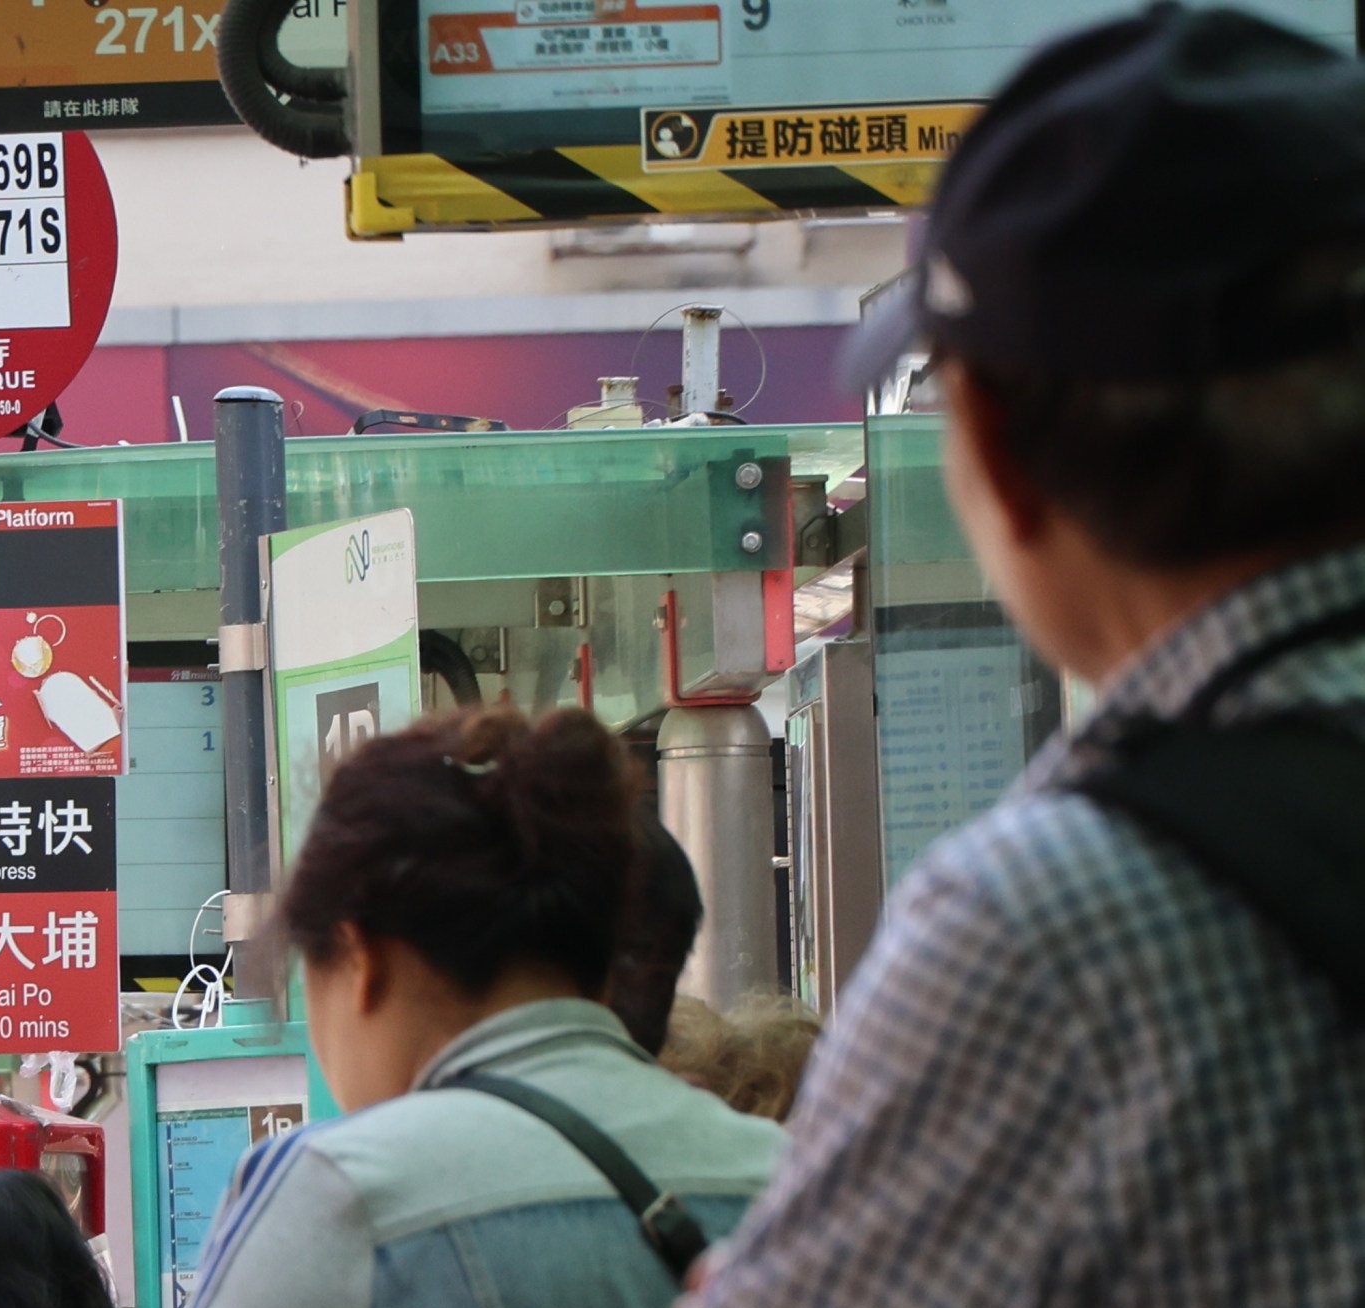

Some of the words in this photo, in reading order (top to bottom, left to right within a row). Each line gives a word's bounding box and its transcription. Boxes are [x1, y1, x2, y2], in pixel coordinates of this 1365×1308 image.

[434, 43, 480, 63] A33
[44, 97, 140, 117] 請在此排隊
[726, 114, 908, 159] 提防碰頭
[918, 125, 961, 150] Min
[201, 686, 214, 706] 3
[203, 731, 214, 751] 1
[23, 984, 51, 1005] Po
[20, 1016, 69, 1039] mins
